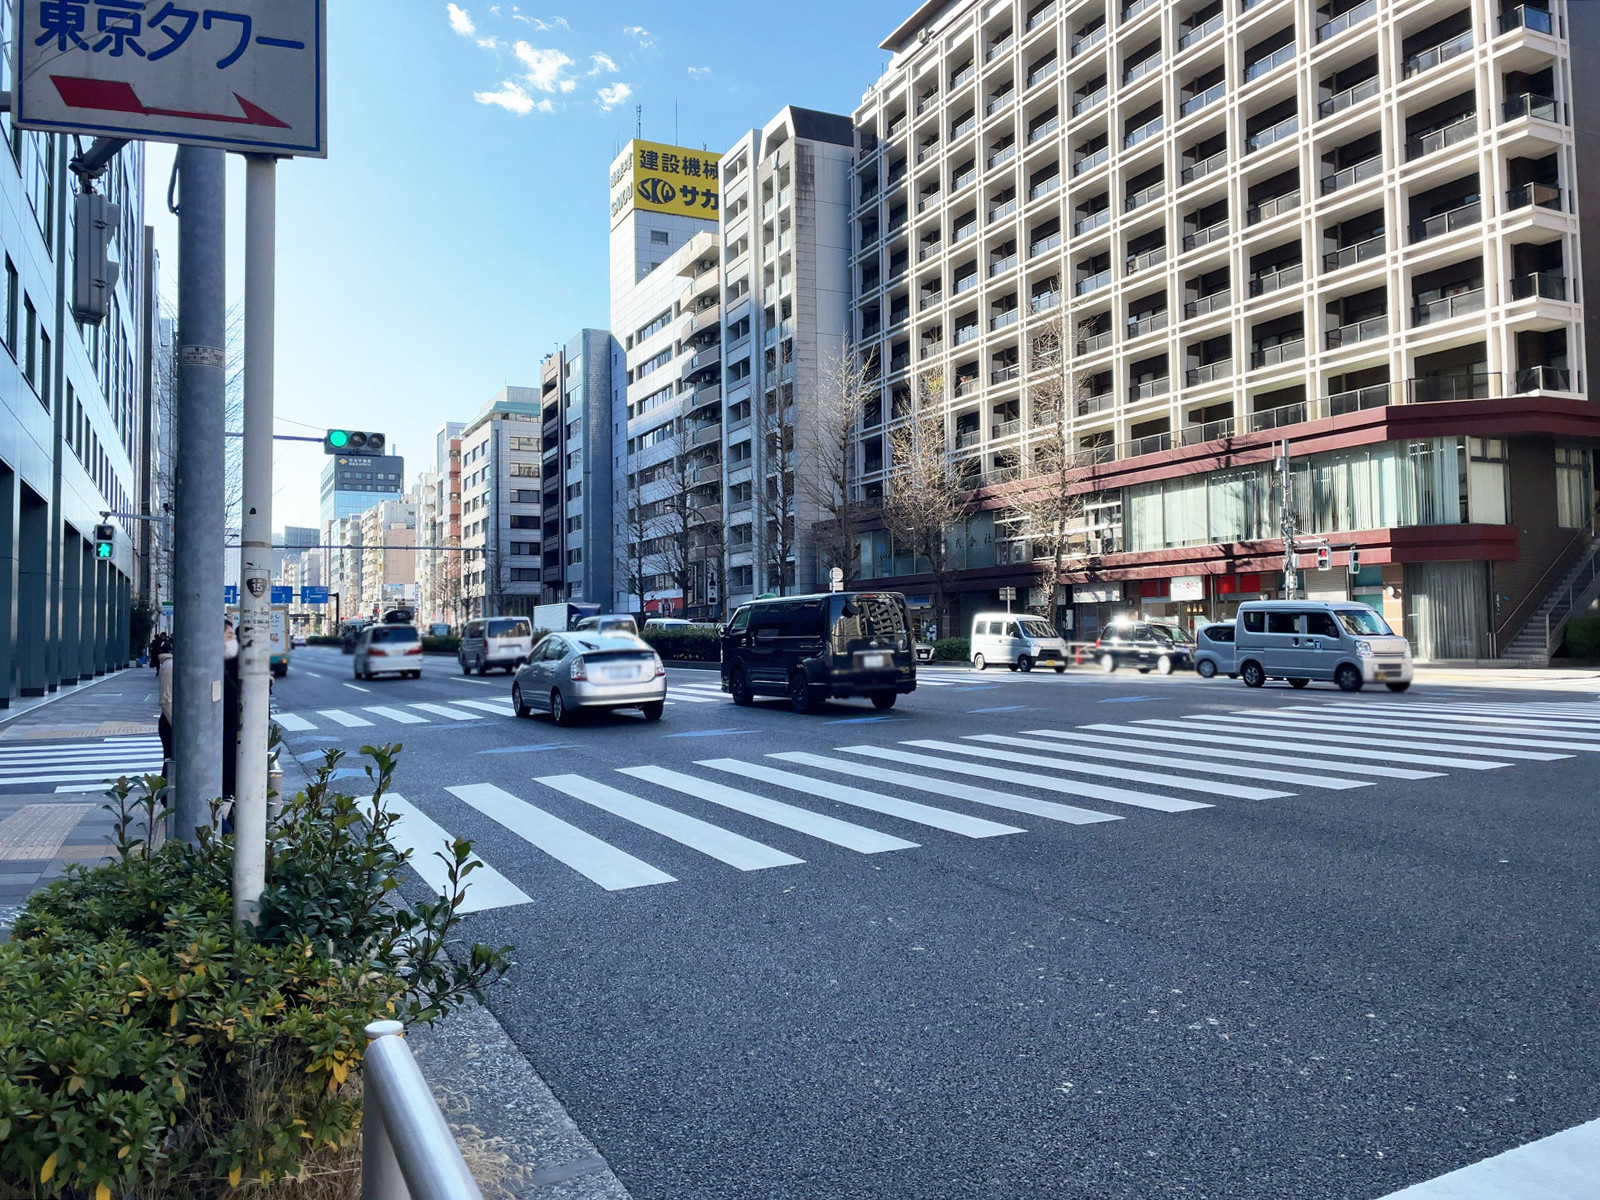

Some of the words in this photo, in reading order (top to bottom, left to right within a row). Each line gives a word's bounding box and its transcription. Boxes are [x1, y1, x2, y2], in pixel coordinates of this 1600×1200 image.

[35, 0, 306, 70] 東京タワー
[640, 149, 718, 179] 建設機械
[679, 184, 718, 211] サカ
